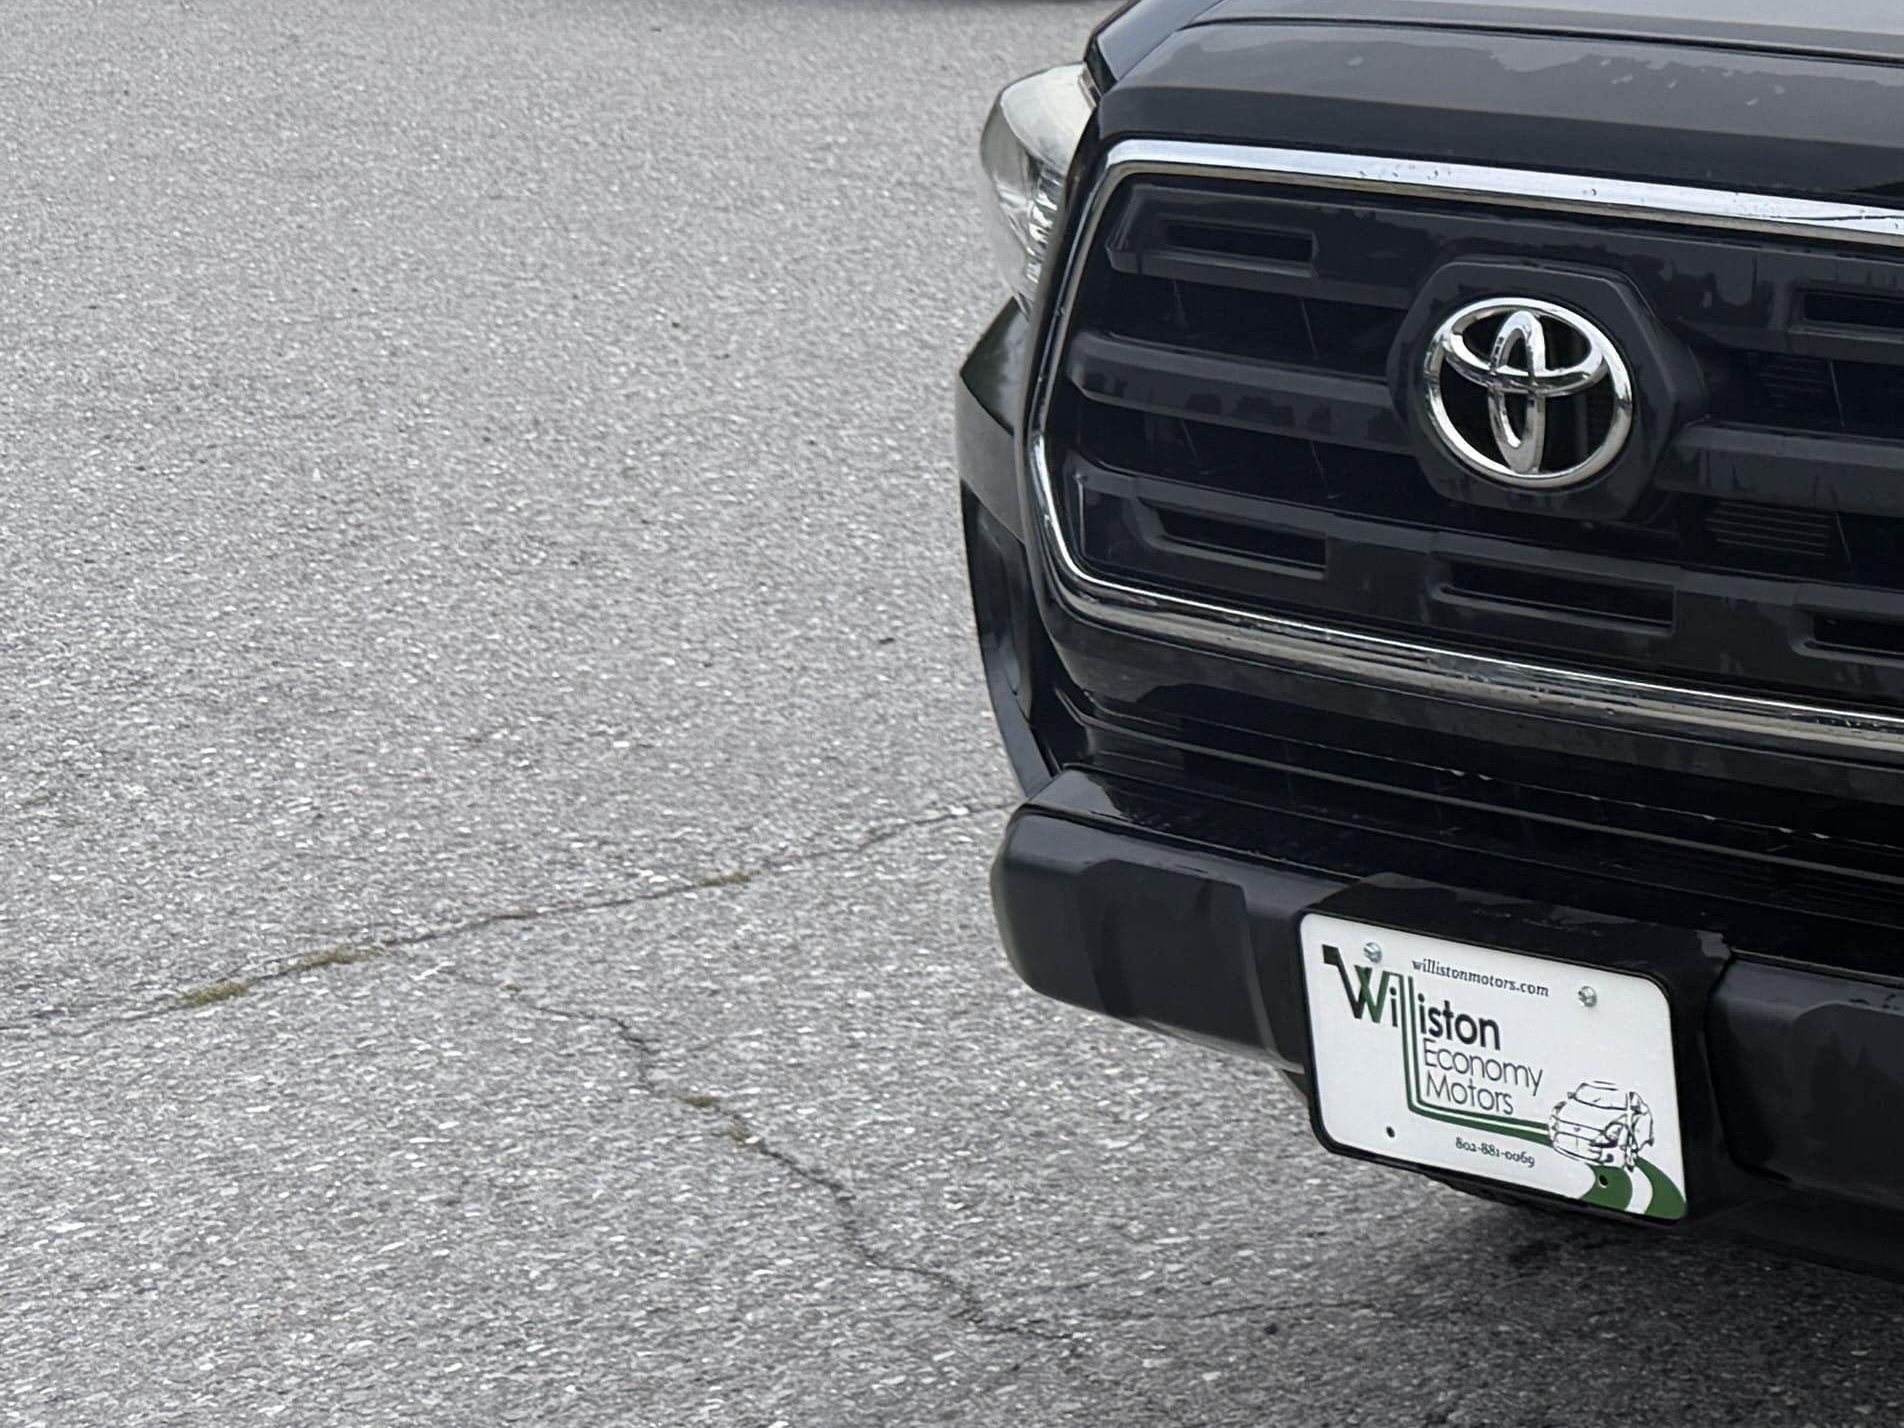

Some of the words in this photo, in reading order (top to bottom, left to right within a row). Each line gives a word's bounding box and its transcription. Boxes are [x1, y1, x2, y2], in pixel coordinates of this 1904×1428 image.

[1321, 943, 1501, 1054] Williston
[1412, 958, 1549, 997] willistonmotors.com
[1423, 1038, 1544, 1097] Economy
[1426, 1071, 1515, 1117] Motors
[1456, 1136, 1536, 1169] 802-881-0069
